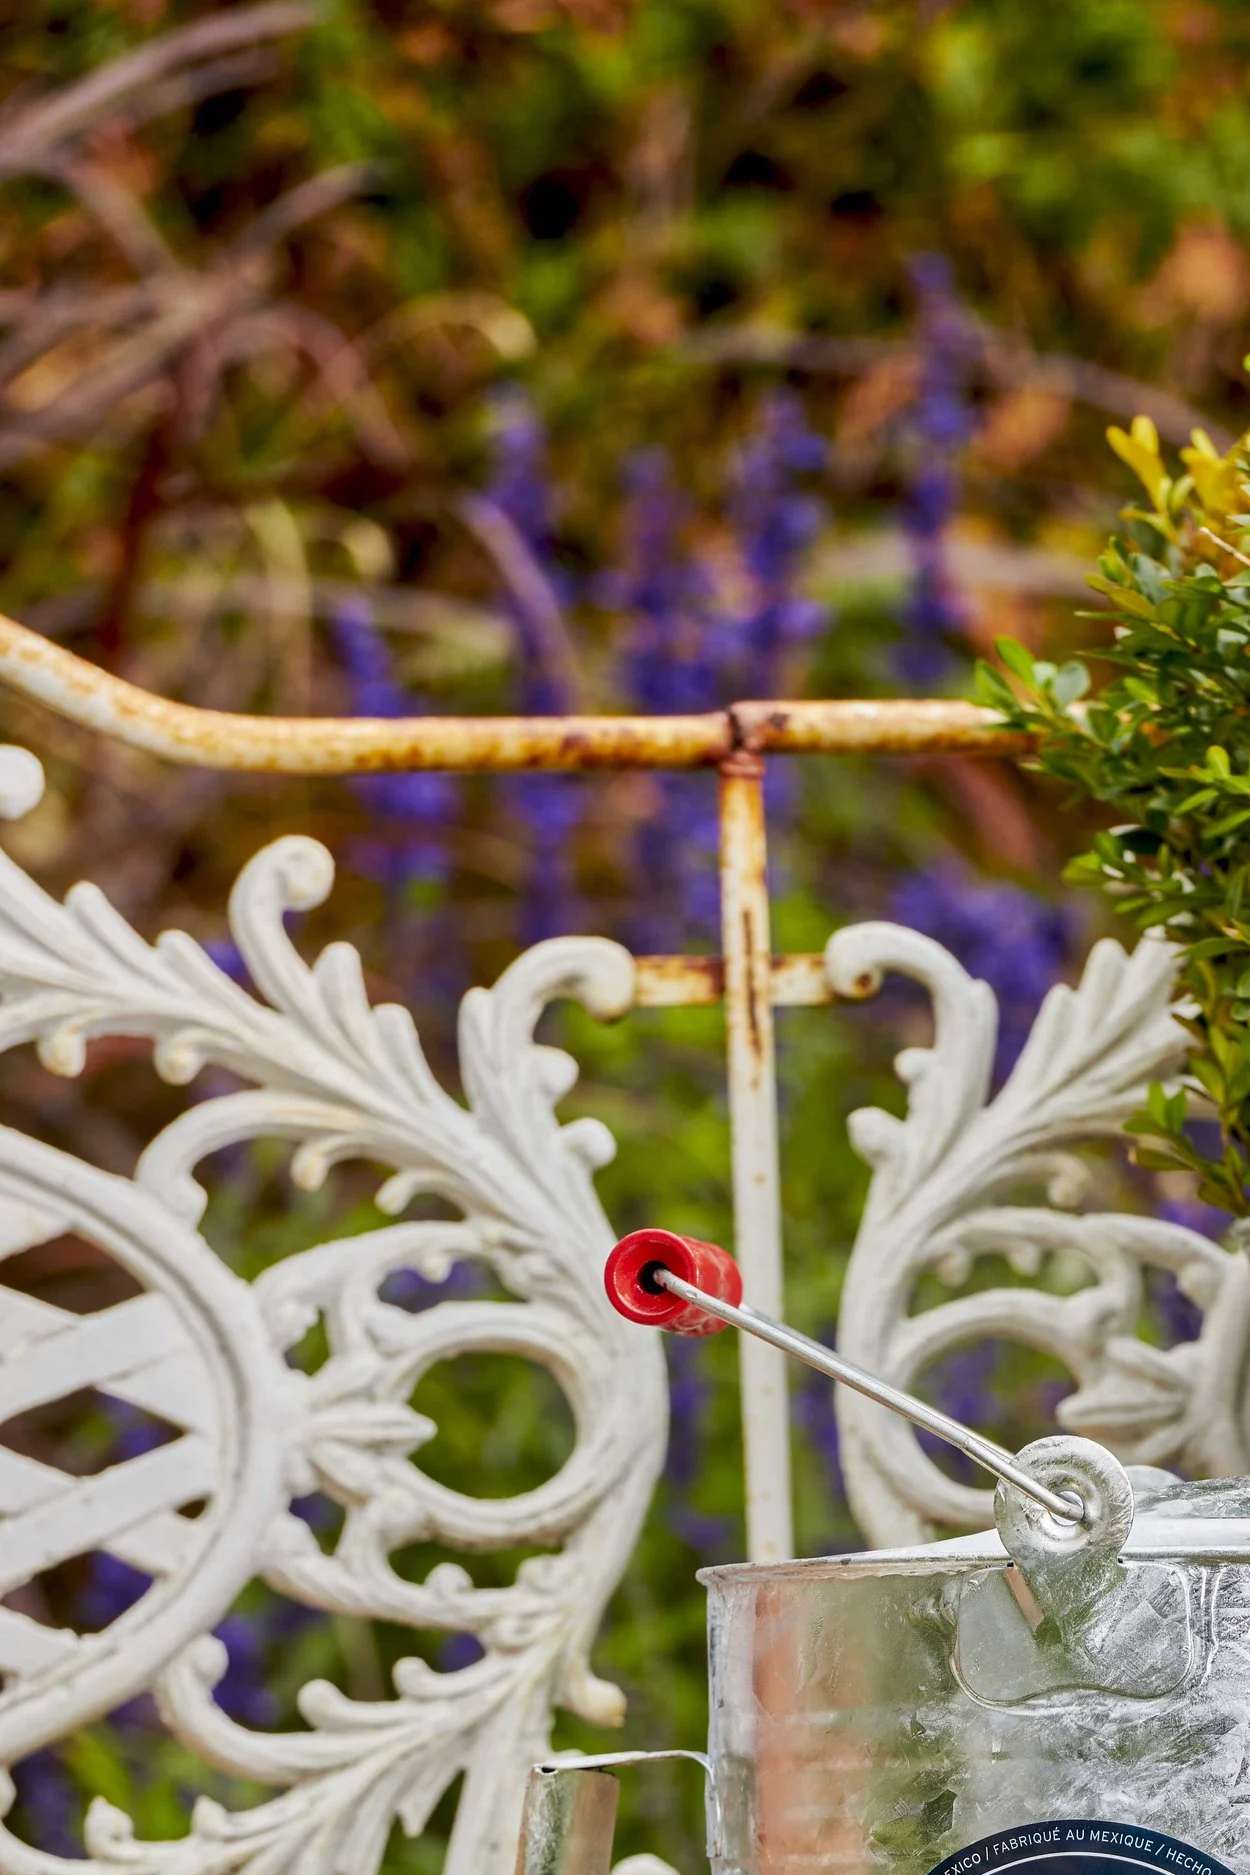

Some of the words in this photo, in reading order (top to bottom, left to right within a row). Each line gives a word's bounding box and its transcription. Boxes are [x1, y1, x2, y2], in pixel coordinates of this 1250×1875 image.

[992, 1826, 1061, 1856] FABRIQUÉ
[1065, 1829, 1085, 1841] AU
[1089, 1829, 1155, 1852] MEXIQUE
